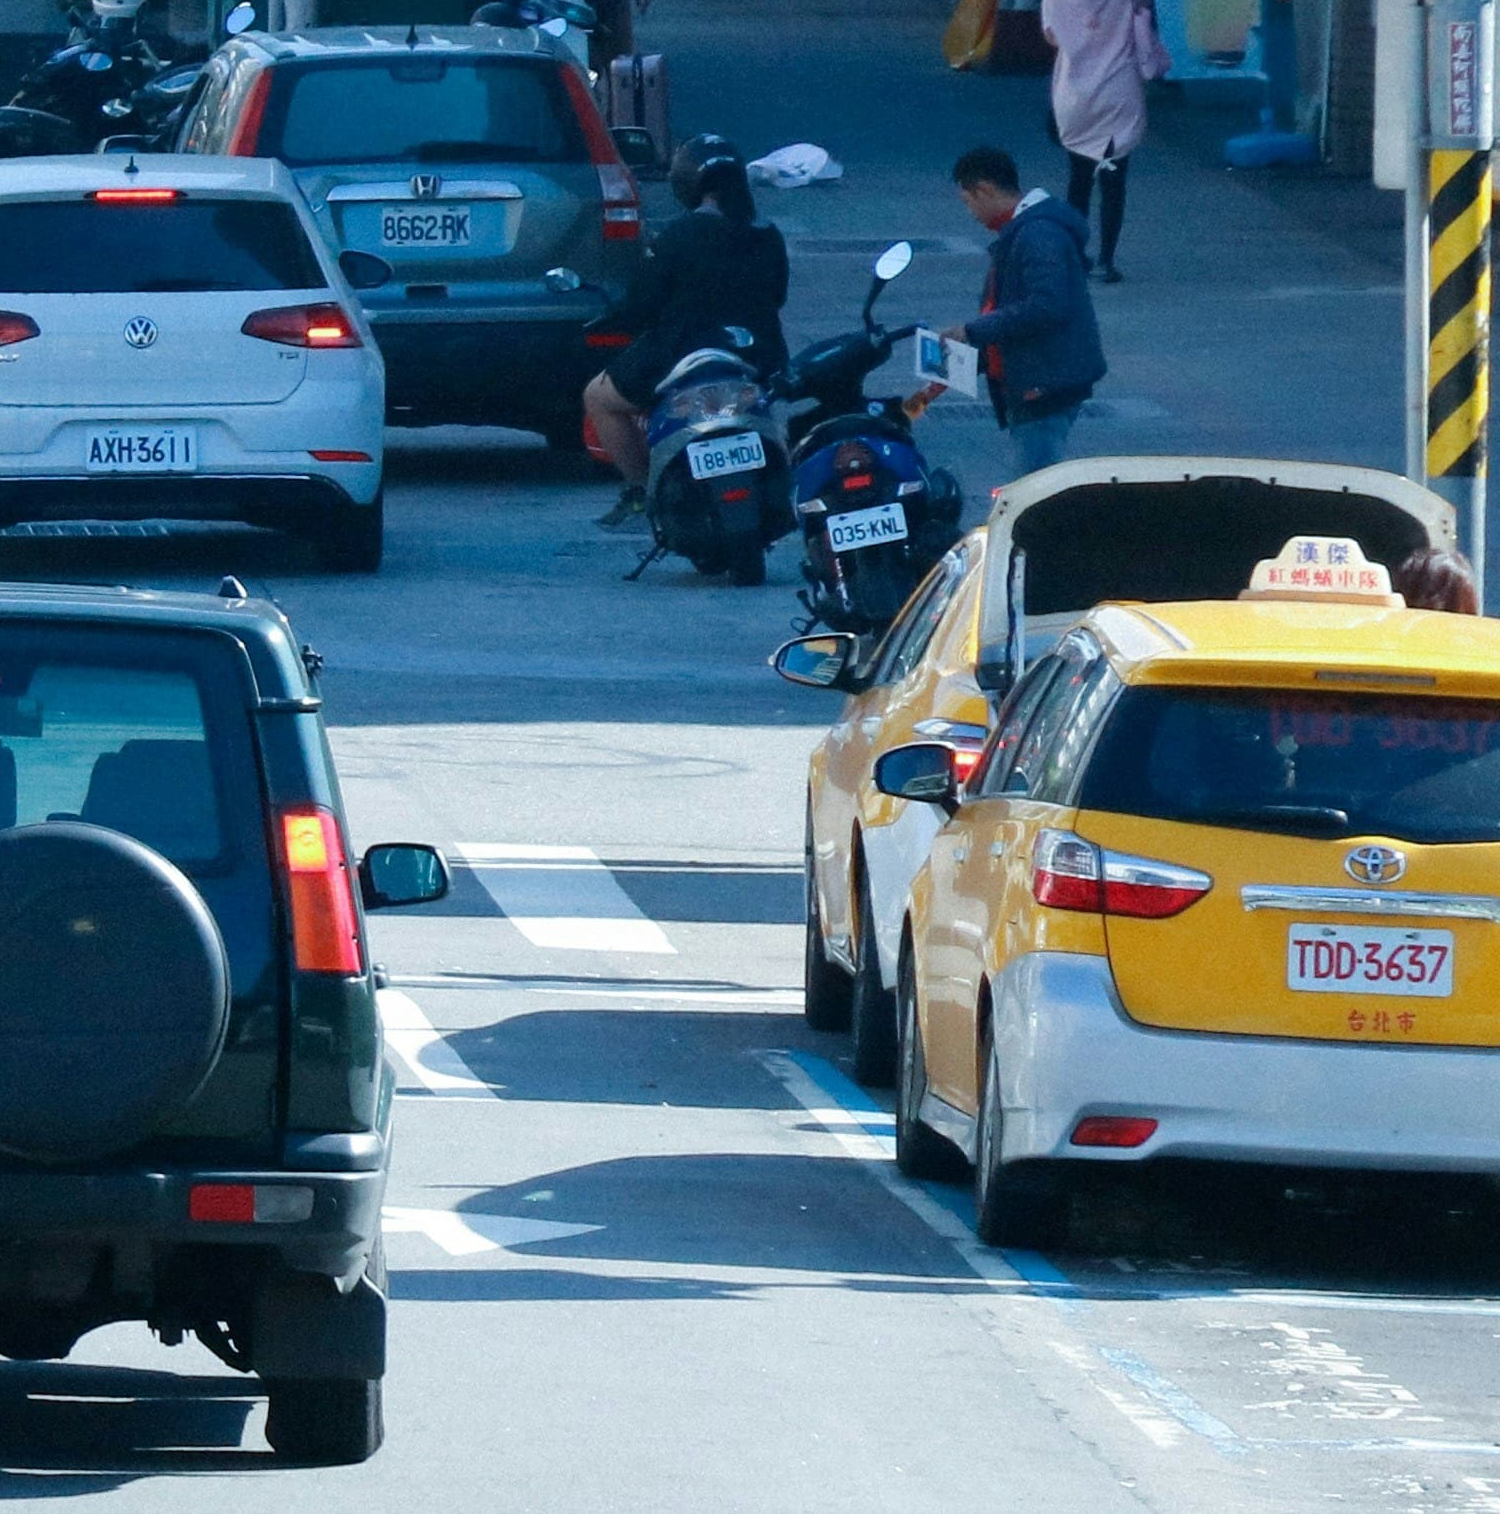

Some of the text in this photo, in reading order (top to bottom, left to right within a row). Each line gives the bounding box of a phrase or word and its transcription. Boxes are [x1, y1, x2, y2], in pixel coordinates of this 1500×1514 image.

[89, 436, 190, 464] AXH-3611
[832, 516, 905, 547] 035-KNL
[1295, 541, 1349, 566] 漢傑
[1267, 567, 1379, 589] 紅螞蟻車隊
[1293, 939, 1449, 984] TDD-3637
[1347, 1008, 1417, 1035] 台北市
